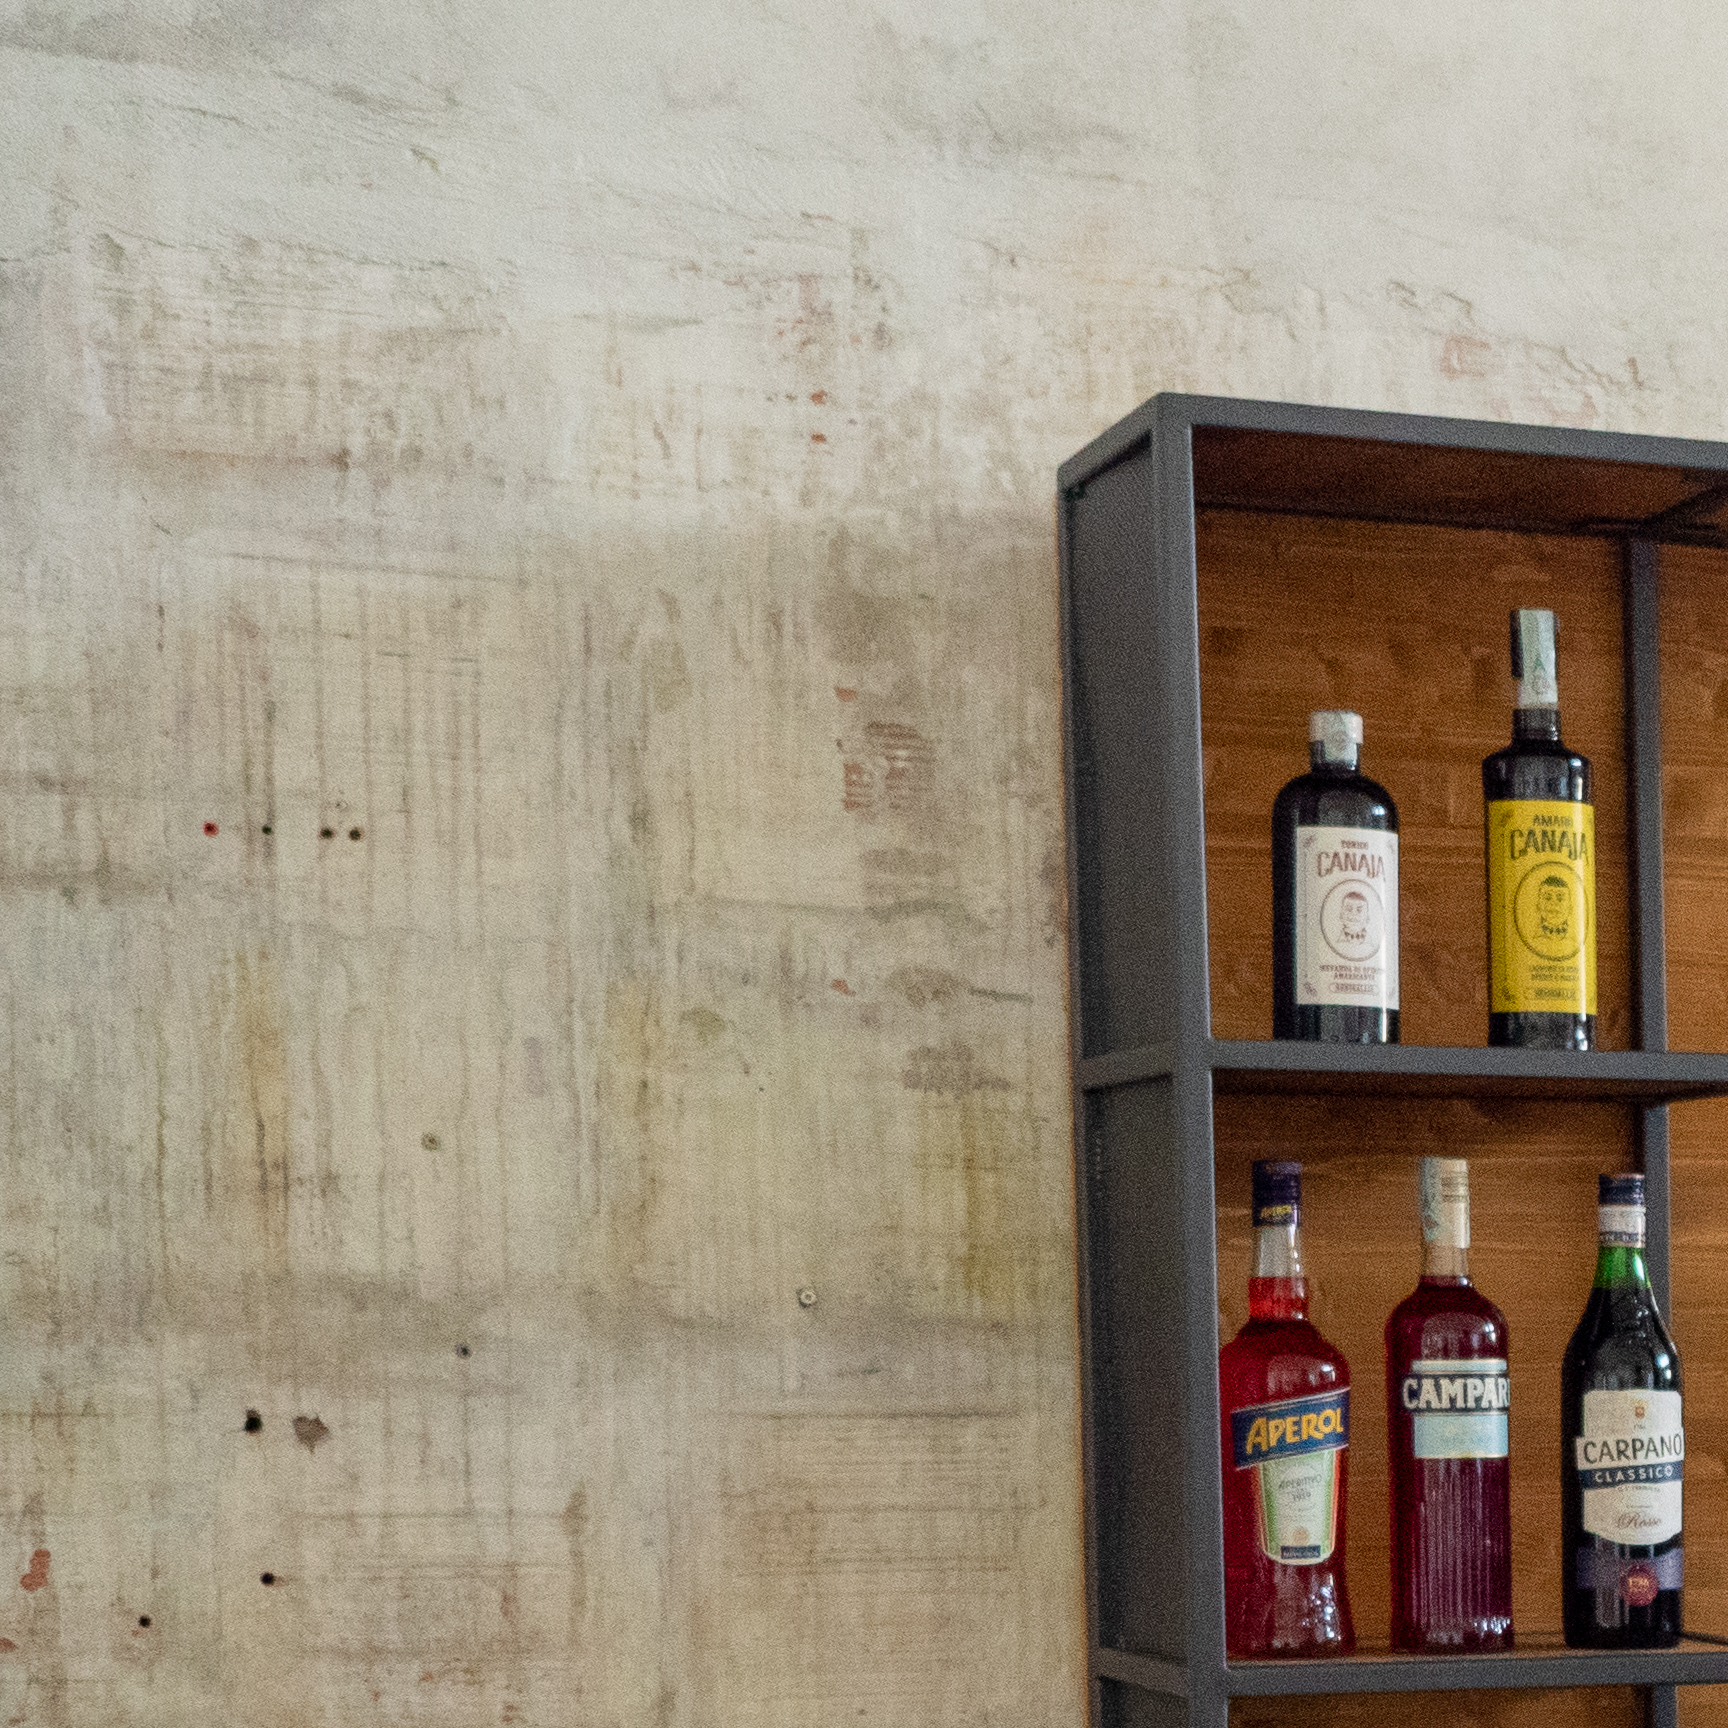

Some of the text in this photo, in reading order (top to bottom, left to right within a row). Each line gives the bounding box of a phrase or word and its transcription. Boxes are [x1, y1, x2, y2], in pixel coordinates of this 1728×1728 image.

[1245, 1408, 1344, 1455] APEROL
[1583, 1433, 1682, 1465] CARPANO
[1594, 1464, 1674, 1484] CLASSICO
